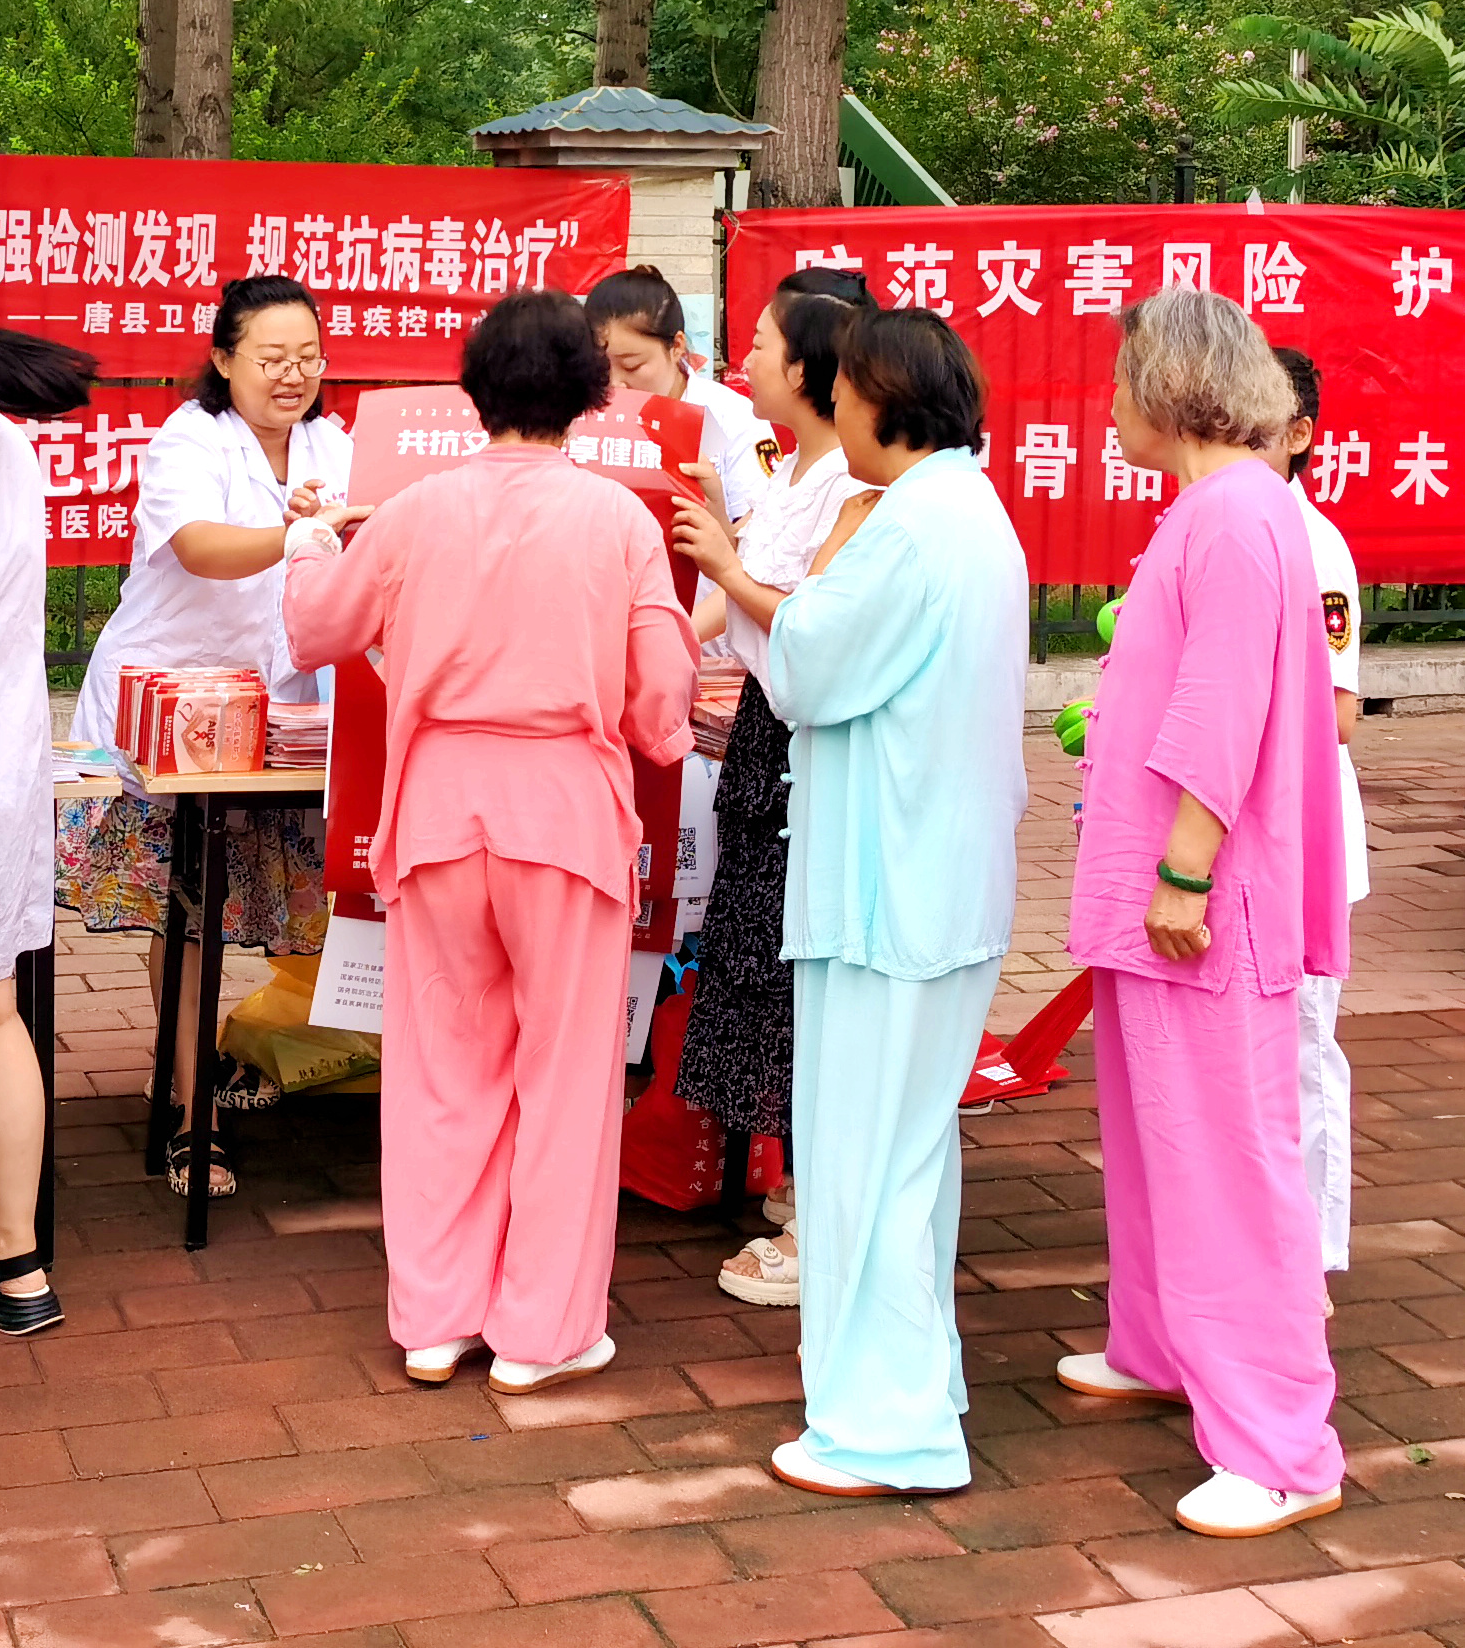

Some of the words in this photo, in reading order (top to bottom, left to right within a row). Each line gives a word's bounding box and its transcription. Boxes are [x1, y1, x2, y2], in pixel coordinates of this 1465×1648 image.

[1391, 245, 1453, 318] 护
[1311, 429, 1450, 506] 护未
[44, 502, 129, 540] 医院
